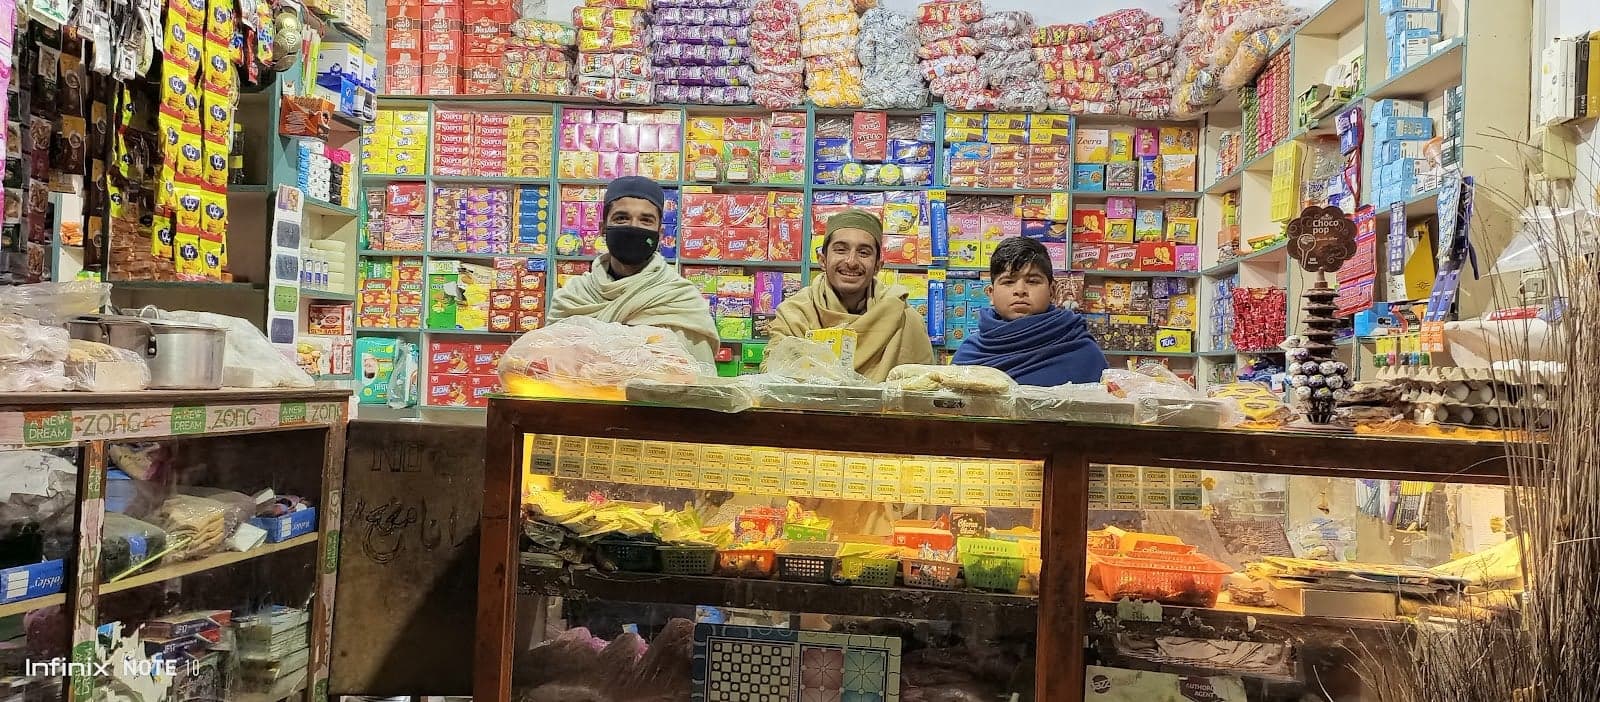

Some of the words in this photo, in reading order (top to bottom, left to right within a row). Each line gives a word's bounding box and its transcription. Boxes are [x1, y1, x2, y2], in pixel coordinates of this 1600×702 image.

[1313, 219, 1339, 227] Choco
[1313, 227, 1329, 235] pop
[685, 239, 703, 249] LION
[728, 240, 747, 250] LION
[1075, 250, 1098, 259] METRO
[1110, 250, 1134, 259] METRO
[1161, 337, 1175, 347] TUC
[433, 352, 450, 363] LION
[475, 354, 492, 364] LION
[432, 386, 449, 396] LION
[174, 420, 202, 431] DREAM
[29, 428, 67, 439] DREAM
